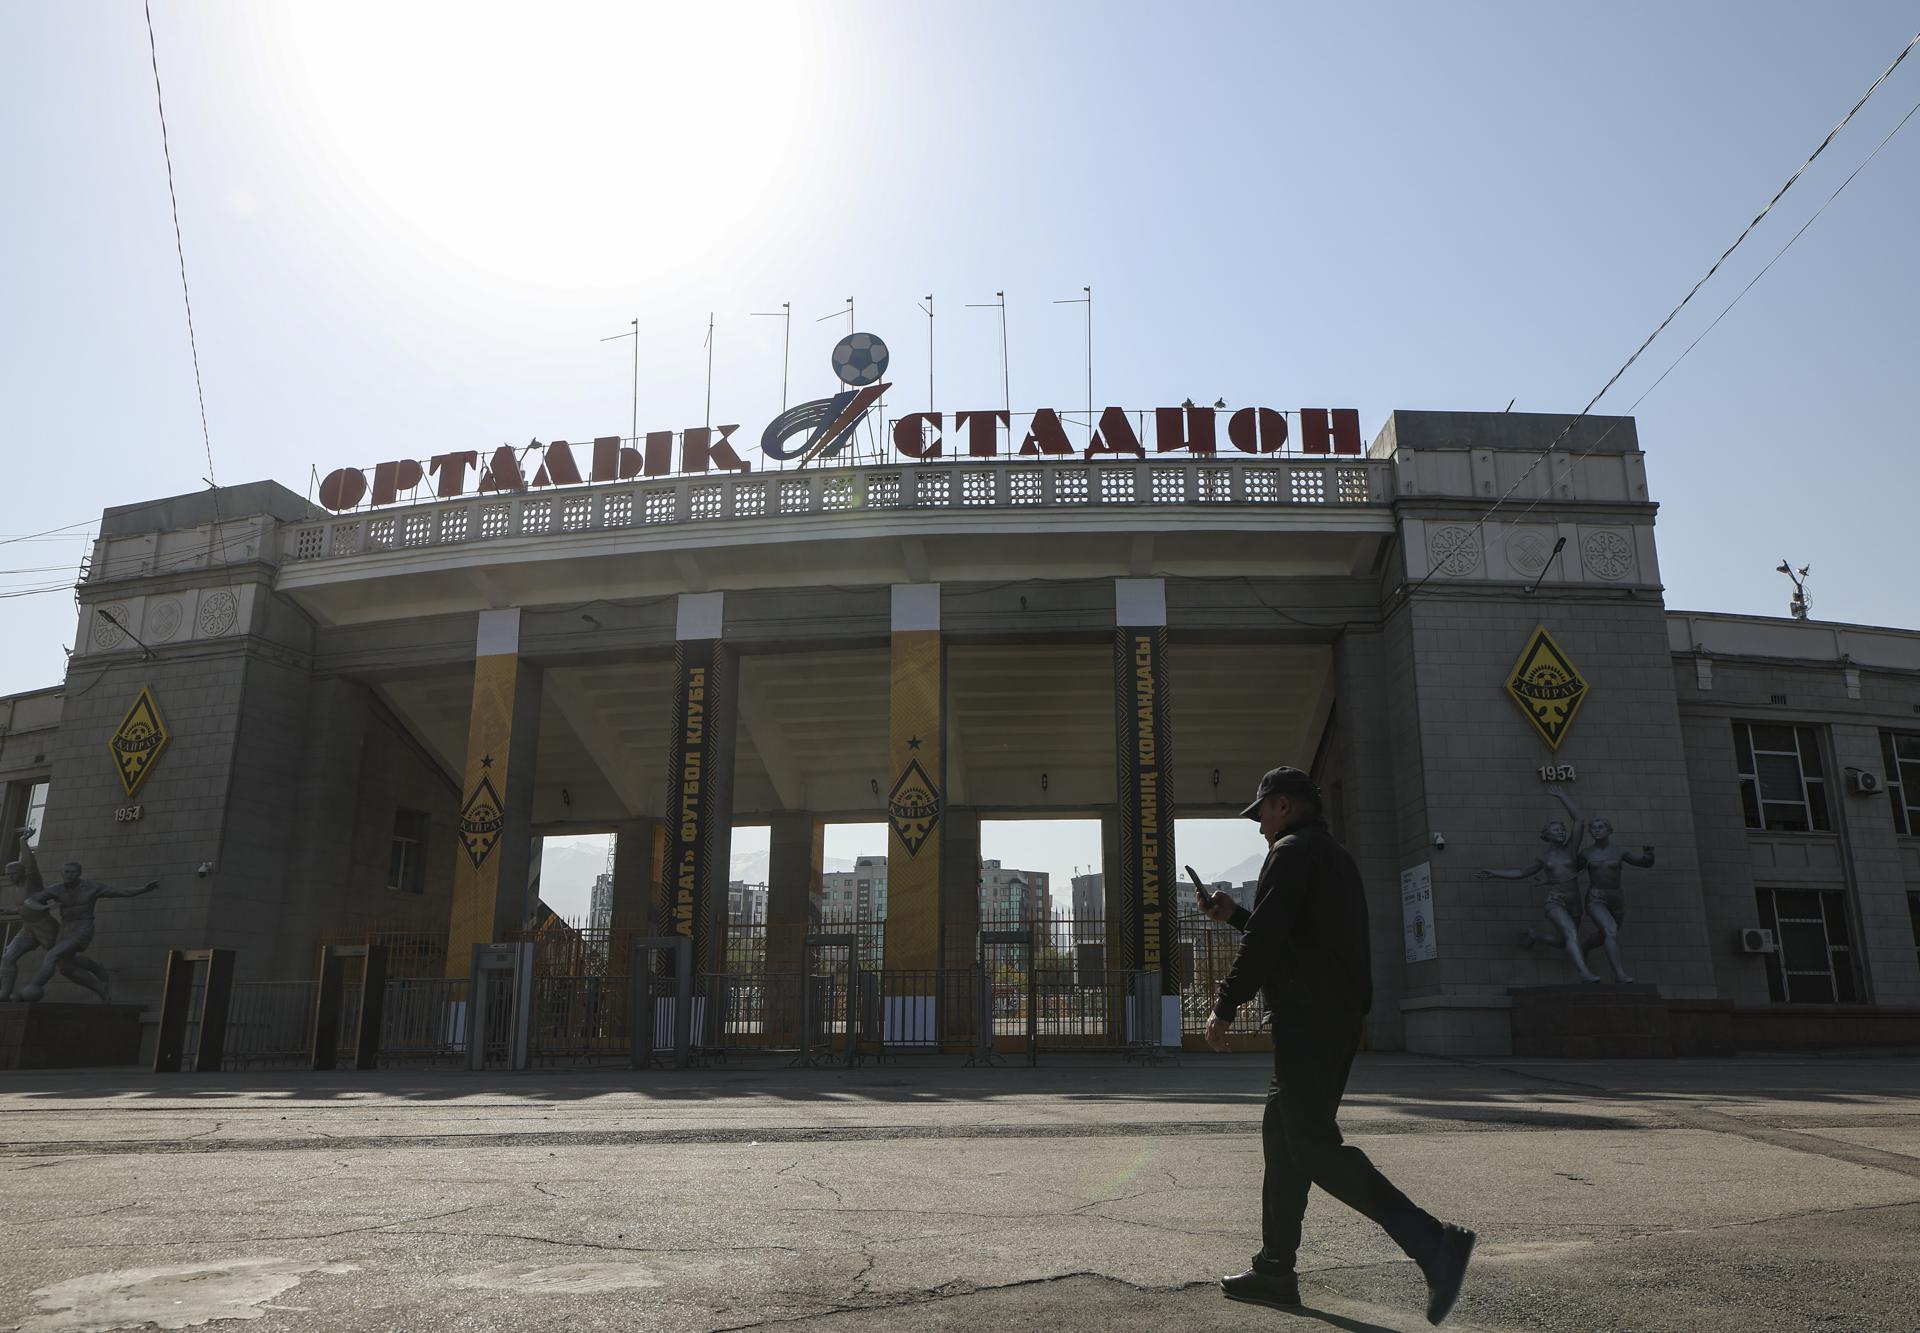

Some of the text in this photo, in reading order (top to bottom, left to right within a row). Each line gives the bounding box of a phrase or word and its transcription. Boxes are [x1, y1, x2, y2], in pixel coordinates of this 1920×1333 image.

[893, 407, 1361, 459] СТАДИОН
[1135, 636, 1155, 765] КОМАНДАСЫ
[1539, 764, 1576, 781] 1954
[114, 805, 141, 821] 1954
[672, 668, 704, 939] АЙРАТ» ФУТБОЛ КЛУБЫ
